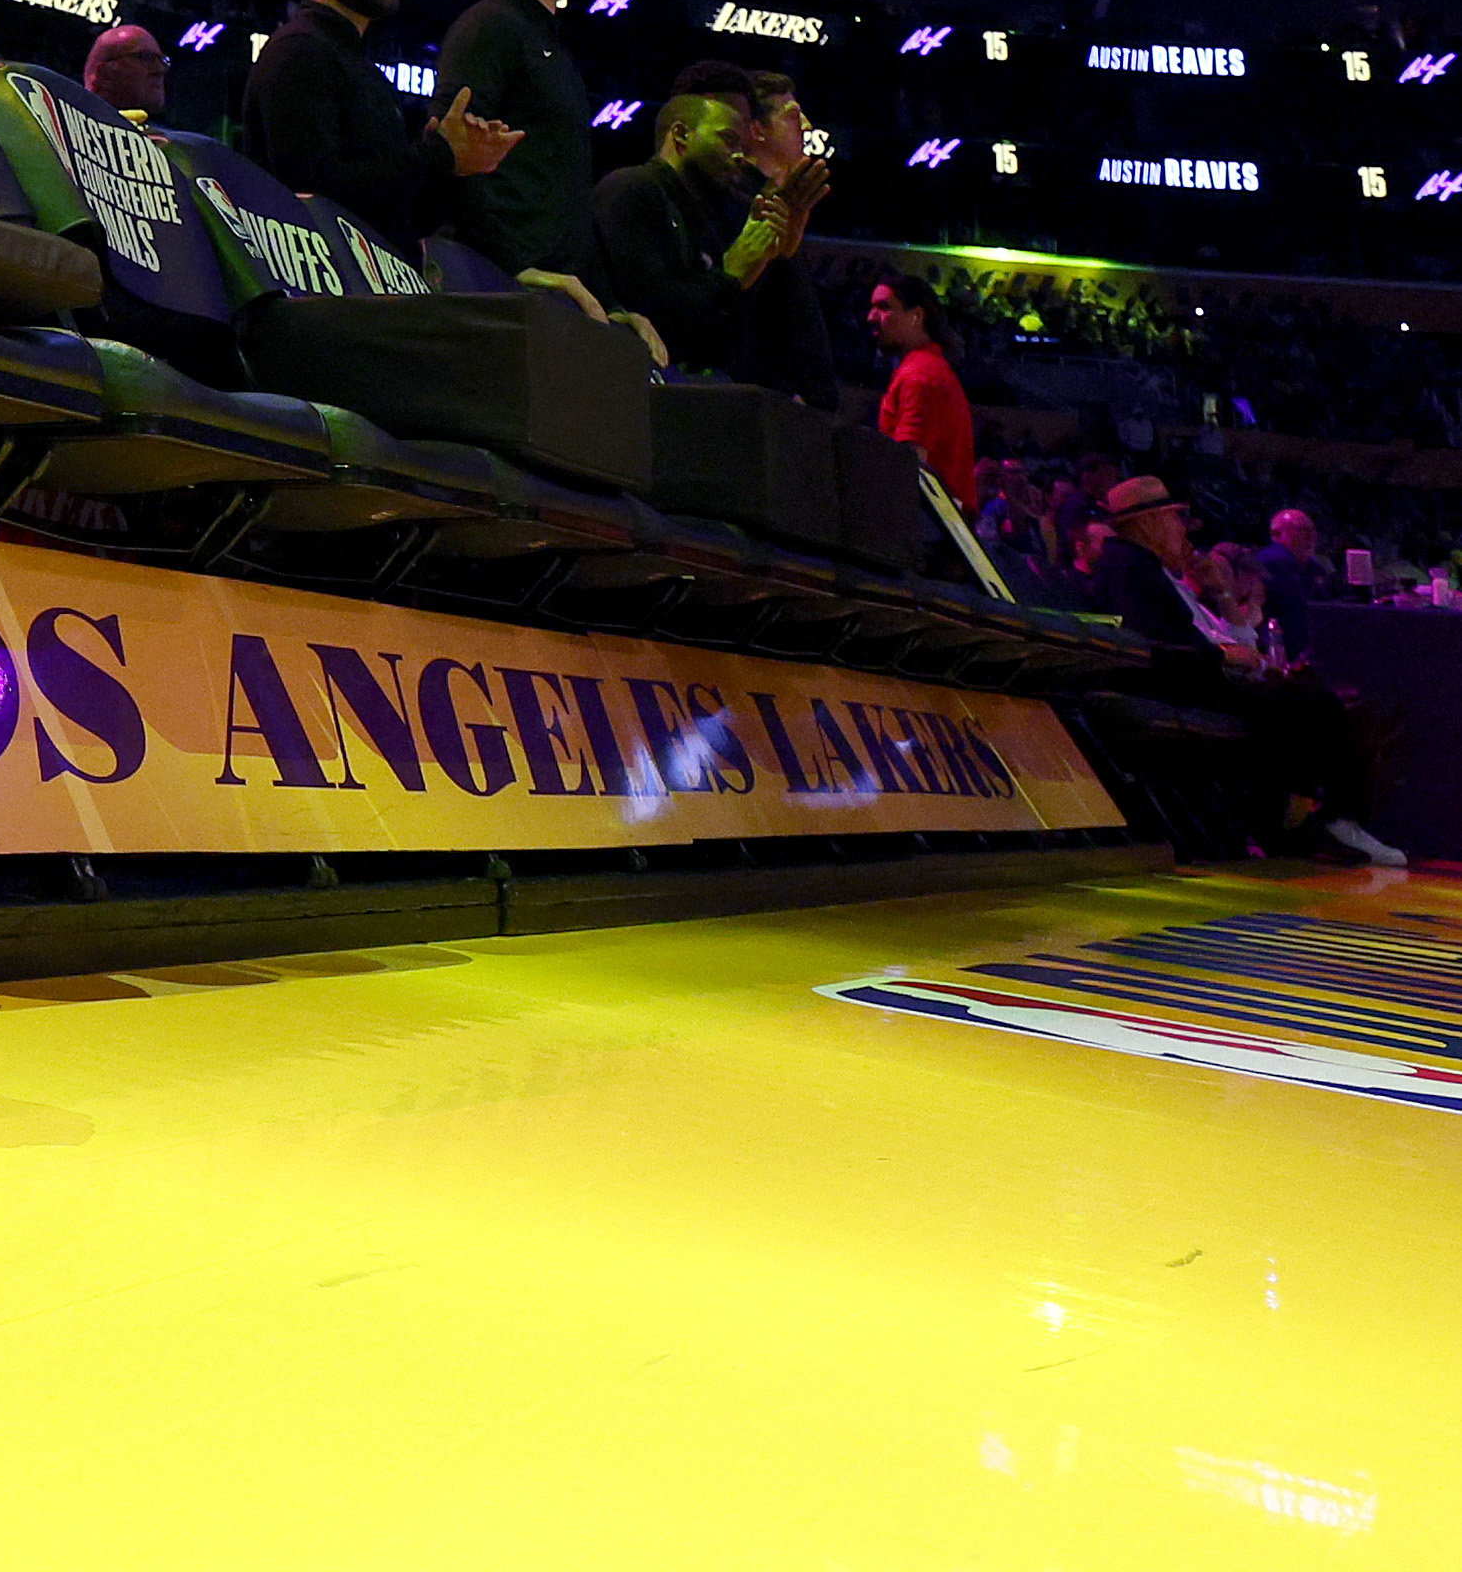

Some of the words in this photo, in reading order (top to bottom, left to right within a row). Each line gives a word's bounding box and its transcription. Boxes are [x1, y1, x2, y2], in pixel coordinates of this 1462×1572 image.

[982, 30, 1008, 61] 15
[1088, 45, 1150, 73] AUSTIN
[1151, 45, 1246, 77] REAVES
[1341, 50, 1371, 82] 15
[57, 99, 175, 186] WESTERN
[991, 141, 1018, 174] 15
[74, 151, 183, 225] CONFERENCE
[1099, 158, 1162, 186] AUSTIN
[1164, 157, 1259, 192] REAVES
[1357, 166, 1387, 198] 15
[214, 632, 757, 798] ANGELES
[746, 690, 1016, 799] LAKERS
